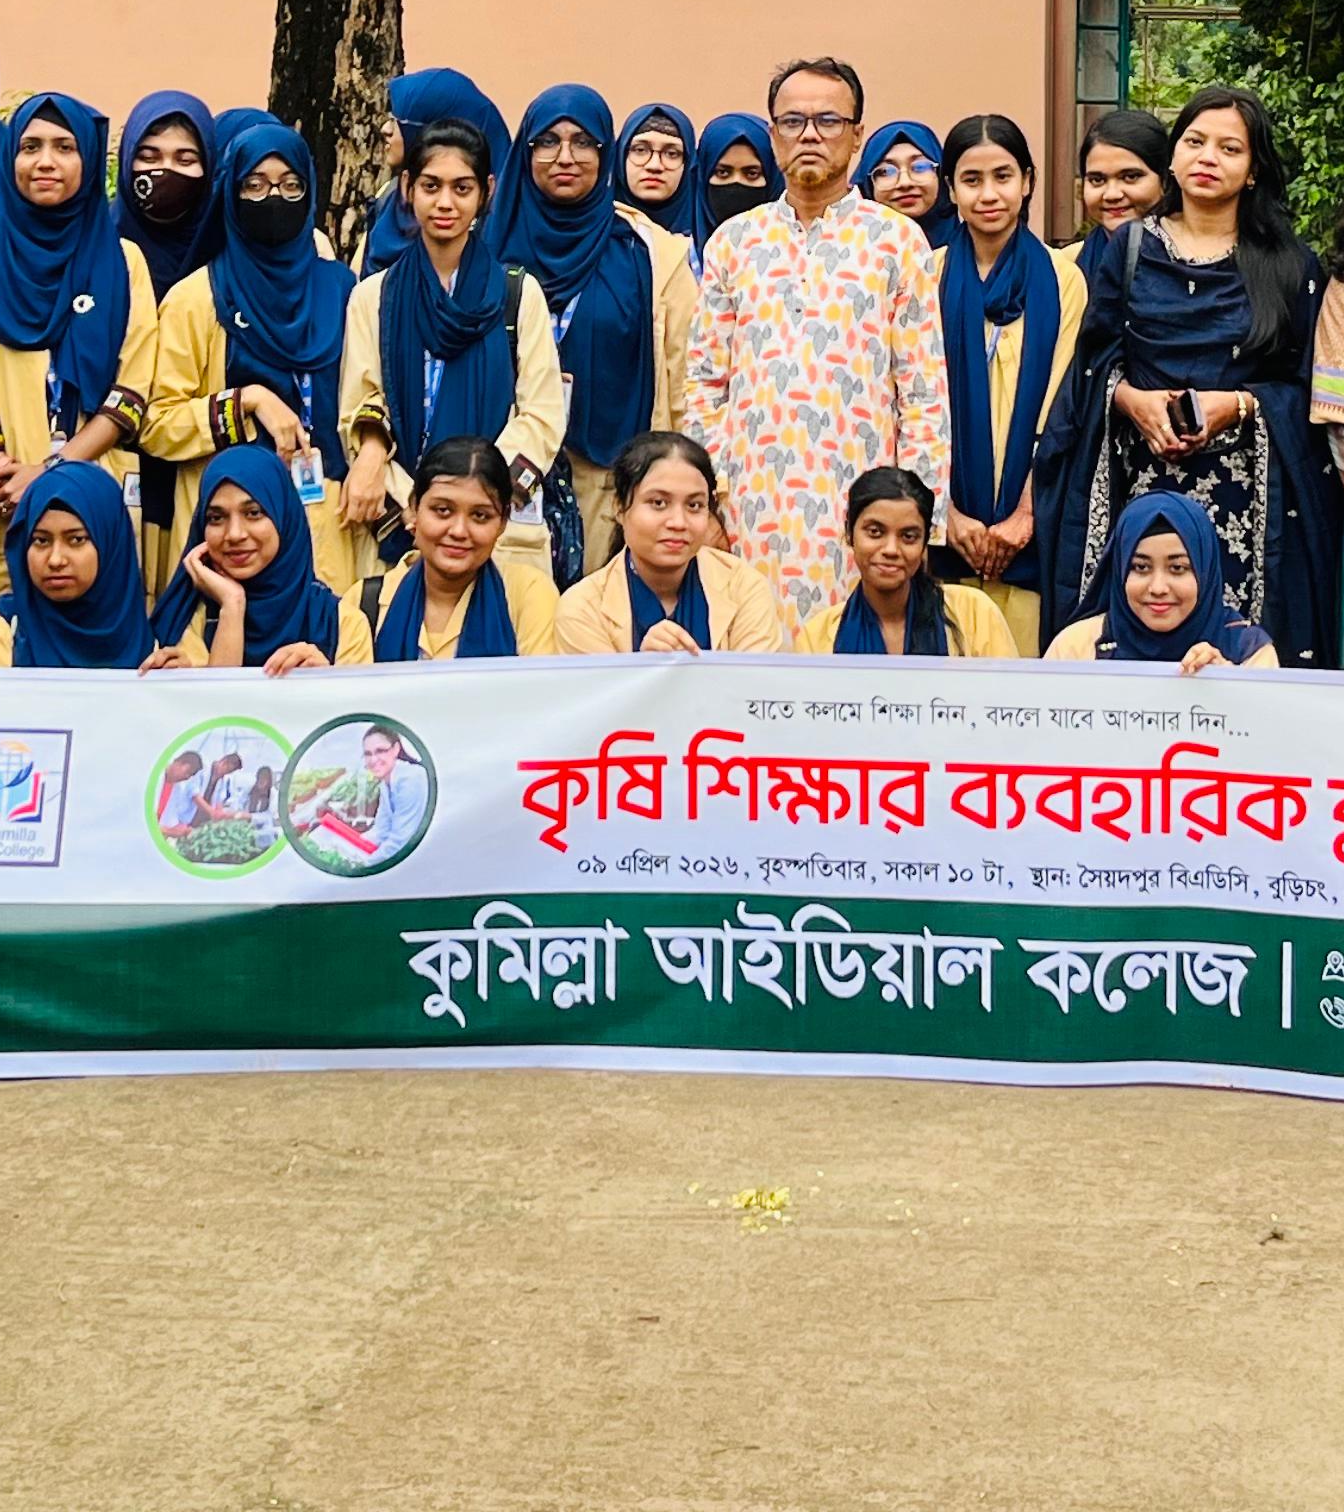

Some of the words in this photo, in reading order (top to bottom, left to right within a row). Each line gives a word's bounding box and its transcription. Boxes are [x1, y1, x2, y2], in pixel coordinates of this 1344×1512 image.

[745, 699, 796, 721] হাতে
[802, 700, 864, 723] কলমে
[869, 695, 923, 725] শিক্ষা
[983, 706, 1041, 728] বদলে
[1047, 707, 1095, 730] যাবে
[1102, 709, 1182, 733] আপনার
[516, 729, 669, 853] কৃষি
[681, 727, 931, 835] শিক্ষার
[944, 740, 1313, 844] ব্যবহারিক
[400, 900, 630, 1029] কুমিল্লা
[644, 900, 1005, 1013] আইডিয়াল
[1017, 938, 1257, 1018] কলেজ
